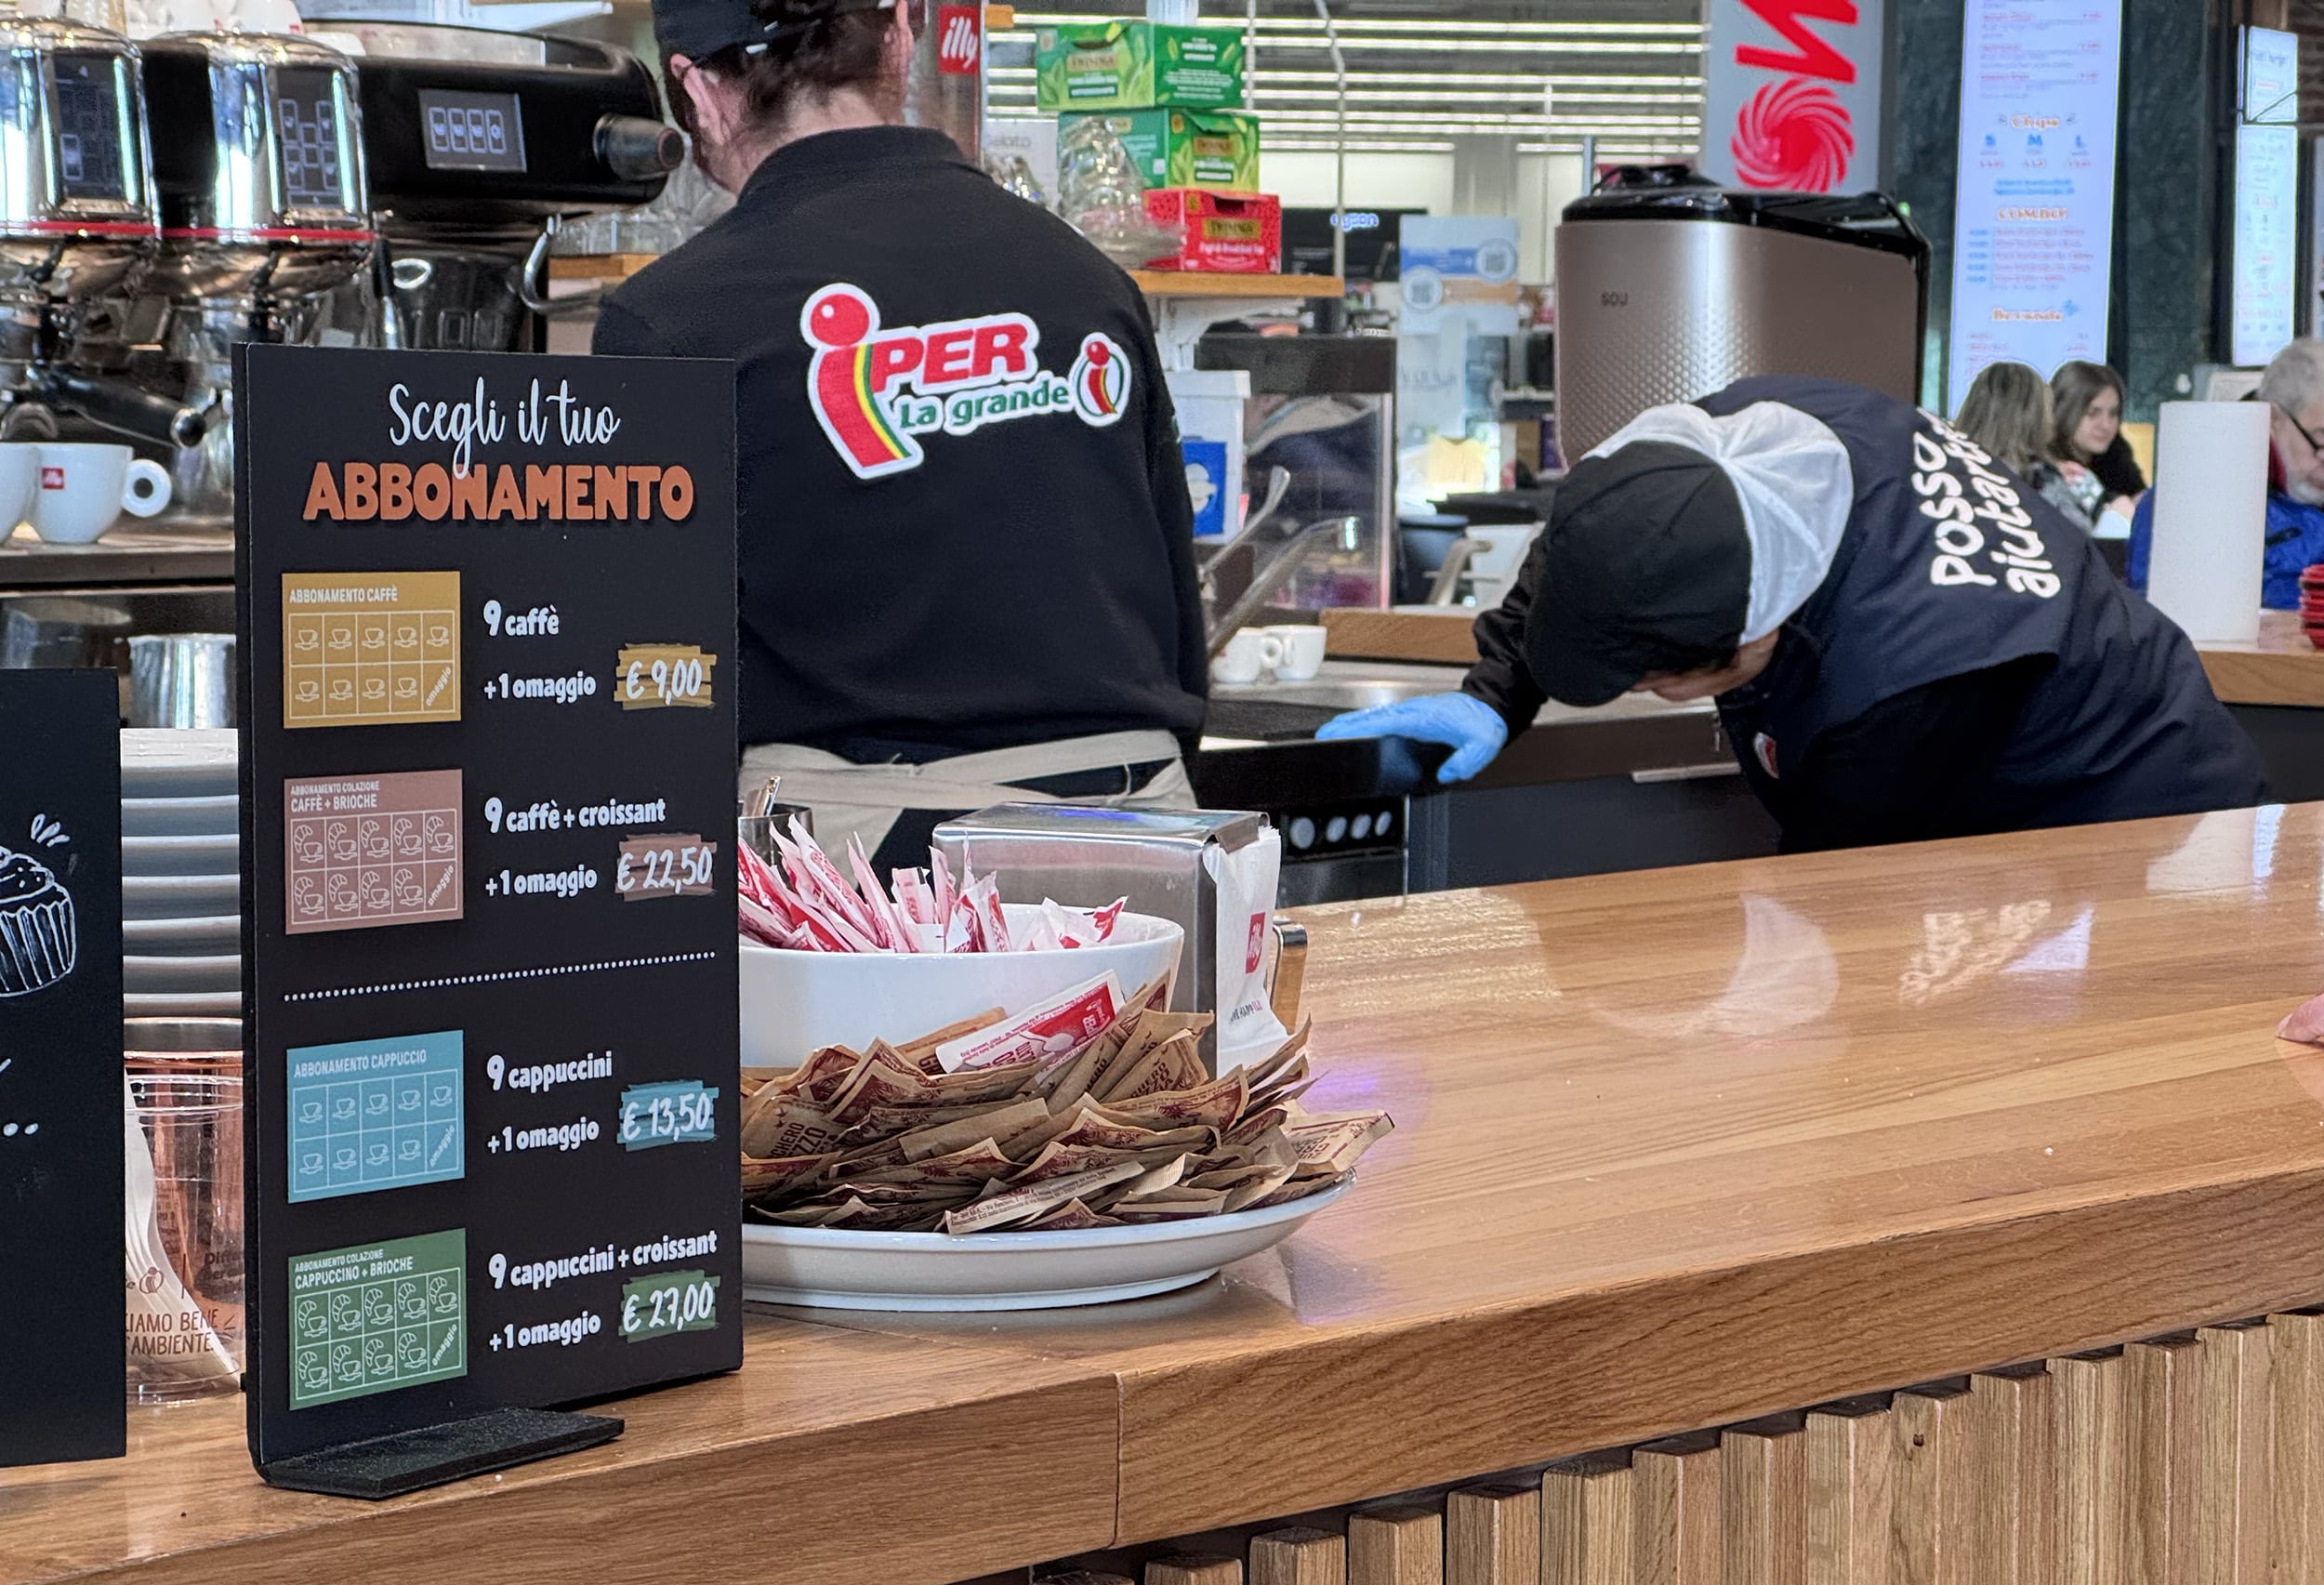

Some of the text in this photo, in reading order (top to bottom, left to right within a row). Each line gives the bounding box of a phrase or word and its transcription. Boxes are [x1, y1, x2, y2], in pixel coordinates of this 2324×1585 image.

[941, 16, 978, 70] illy
[900, 403, 936, 428] La
[952, 379, 1069, 426] grande
[389, 376, 620, 480] Scegli il tuo
[303, 461, 693, 521] ABBONAMENTO
[289, 585, 398, 603] ABBONAMENTO CAFFÈ
[483, 600, 560, 636] 9 caffè
[513, 670, 596, 704] omaggio
[652, 658, 703, 706] 9,00
[290, 783, 341, 796] ABBONAMENTO
[291, 794, 323, 812] CAFFÈ
[333, 794, 376, 810] BRIOCHE
[484, 797, 503, 833] 9
[506, 800, 560, 833] caffè
[578, 798, 666, 827] croissant
[514, 865, 598, 898] omaggio
[642, 846, 714, 893] 22,50
[293, 1056, 370, 1079] ABBONAMENTO
[486, 1050, 613, 1093] 9 cappuccini
[516, 1116, 600, 1152] omaggio
[648, 1091, 712, 1142] 13,50
[770, 1121, 807, 1158] CHERO
[295, 1265, 360, 1290] CAPPUCCINO
[369, 1256, 414, 1277] BRIOCHE
[488, 1252, 507, 1289] 9
[510, 1244, 614, 1290] cappuccini
[632, 1230, 717, 1267] croissant
[179, 1308, 219, 1332] BENE
[648, 1281, 714, 1332] 27,00
[517, 1313, 601, 1348] omaggio
